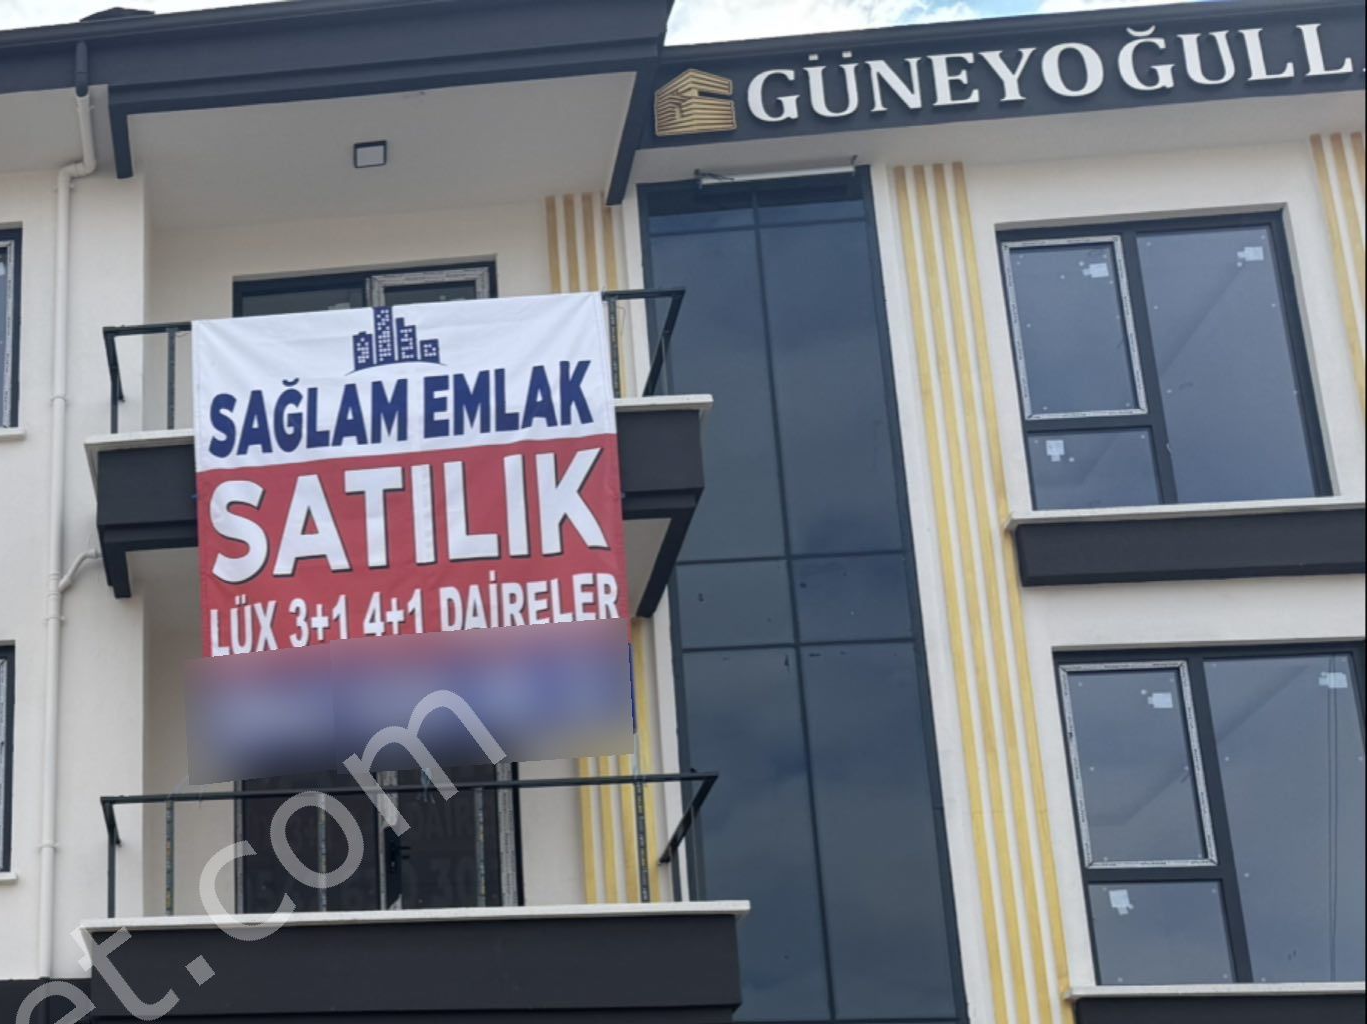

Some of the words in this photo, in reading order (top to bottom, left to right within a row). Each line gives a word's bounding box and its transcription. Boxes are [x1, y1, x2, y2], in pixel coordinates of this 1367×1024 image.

[747, 22, 1365, 123] GÜNEYOĞULL
[208, 377, 409, 459] SAĞLAM
[422, 359, 594, 439] EMLAK
[209, 447, 611, 585] SATILIK
[209, 595, 277, 657] LÜX
[289, 594, 348, 649] 3+1
[363, 589, 425, 637] 4+1
[439, 571, 620, 633] DAİRELER
